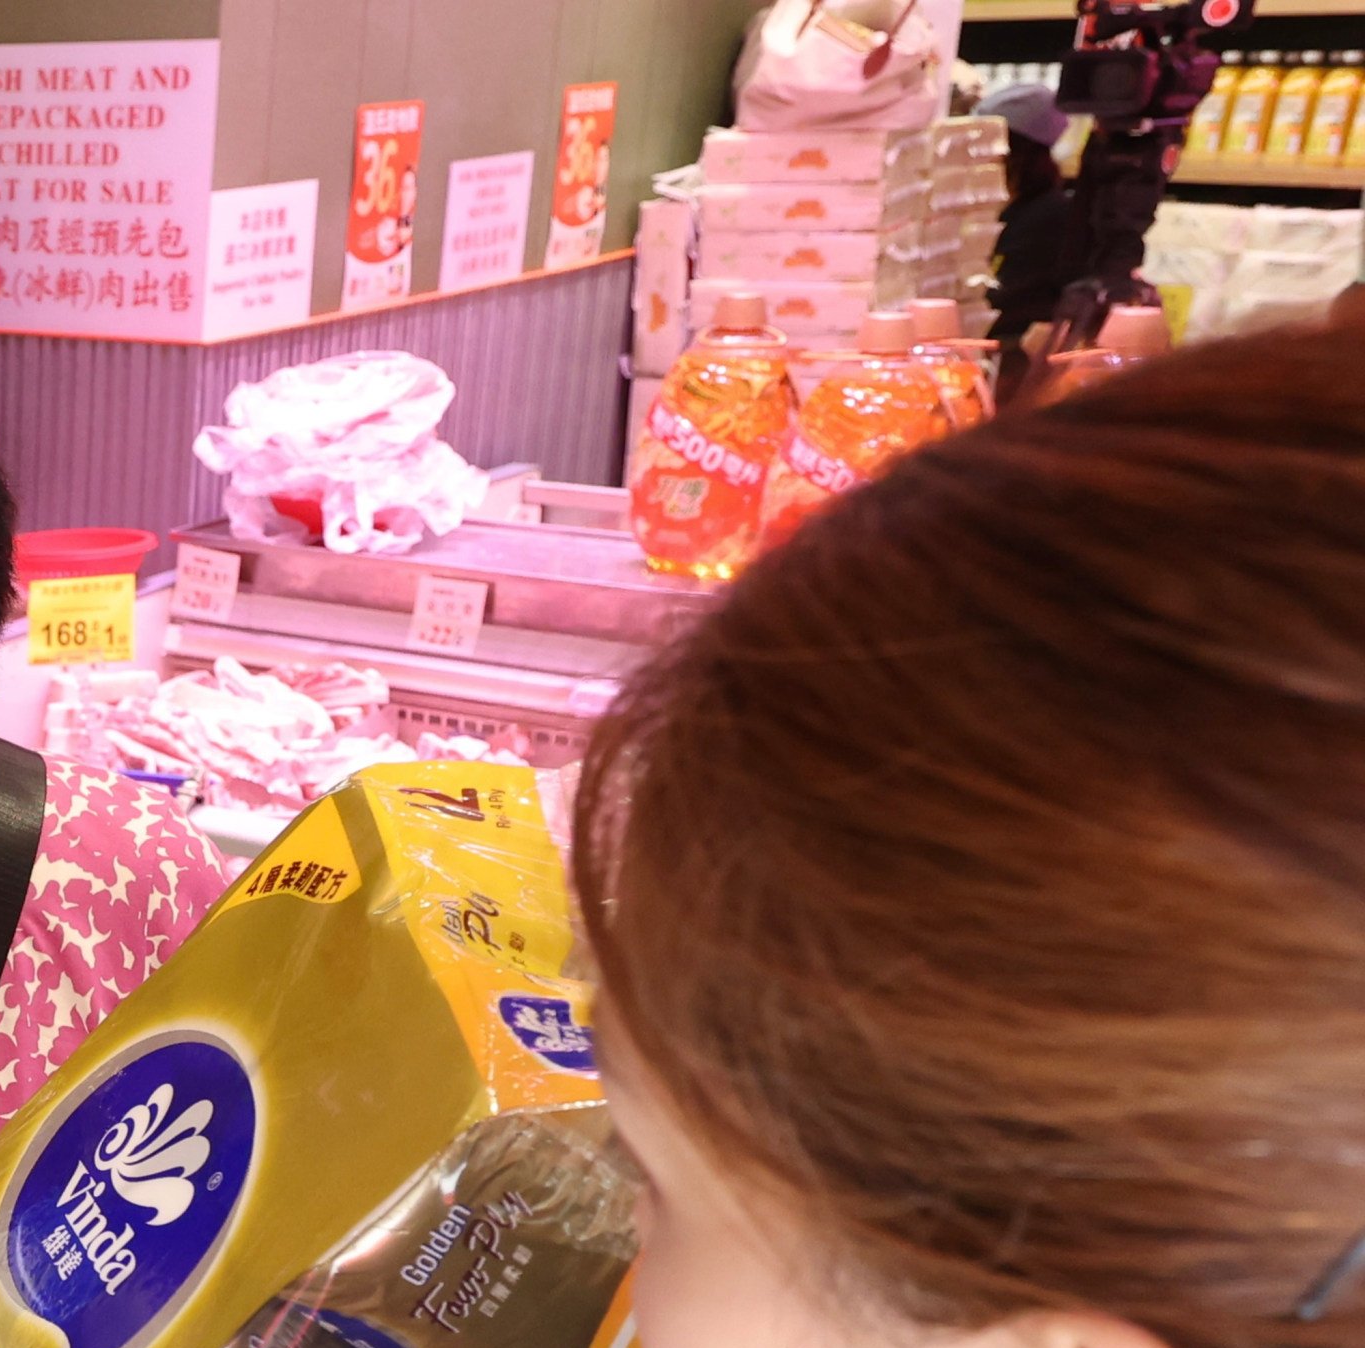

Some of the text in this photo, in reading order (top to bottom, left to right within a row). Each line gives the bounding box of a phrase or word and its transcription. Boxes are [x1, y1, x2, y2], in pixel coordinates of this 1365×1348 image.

[37, 66, 116, 92] MEAT
[129, 64, 192, 92] AND
[32, 179, 88, 203] FOR
[99, 180, 174, 205] SALE
[41, 620, 88, 647] 168
[41, 1224, 84, 1282] 維達
[56, 1159, 137, 1296] Vinda
[400, 1203, 471, 1288] Golden
[410, 1191, 533, 1335] Four-Ply
